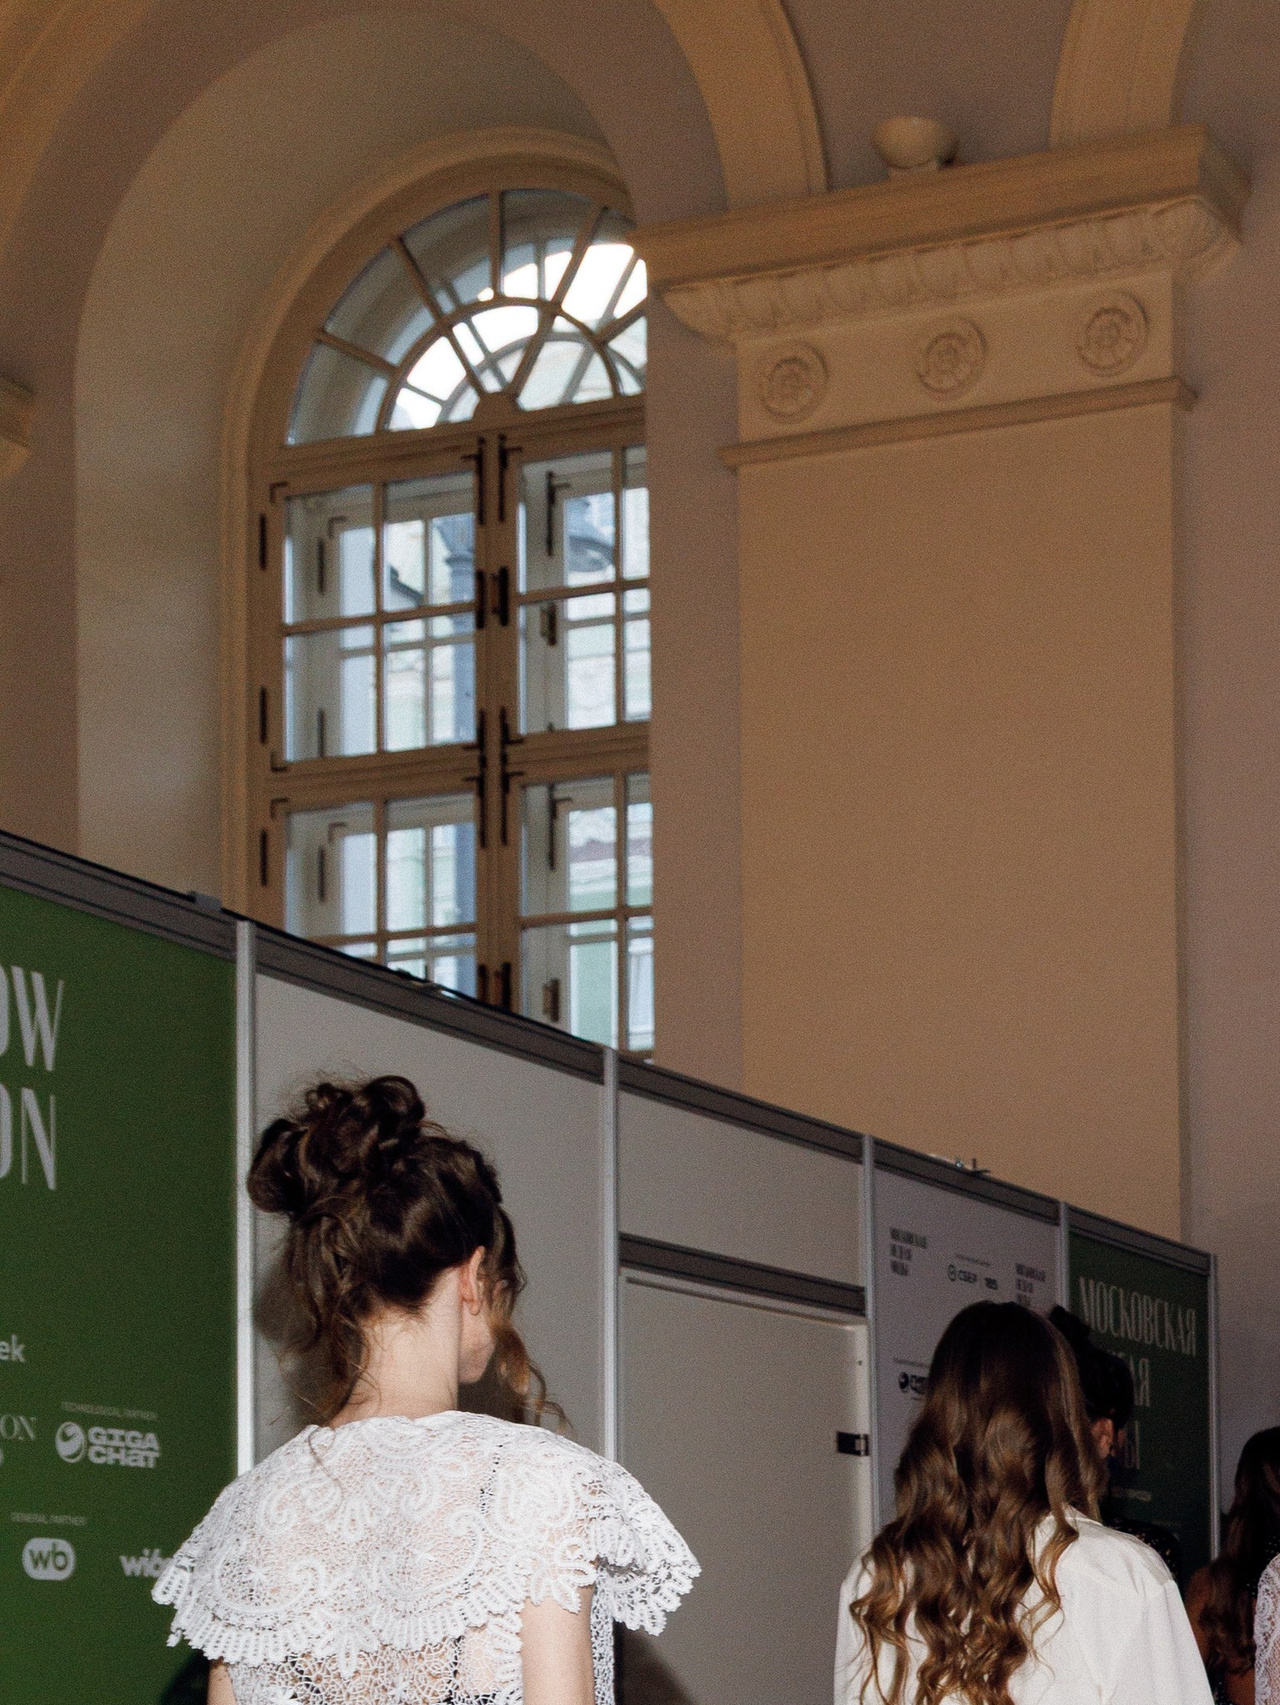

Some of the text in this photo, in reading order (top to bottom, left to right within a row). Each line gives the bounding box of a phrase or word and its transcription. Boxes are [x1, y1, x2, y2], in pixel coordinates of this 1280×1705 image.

[1079, 1276, 1197, 1357] МОСКОВСКАЯ
[87, 1426, 160, 1451] GIGA
[28, 1542, 68, 1572] wb
